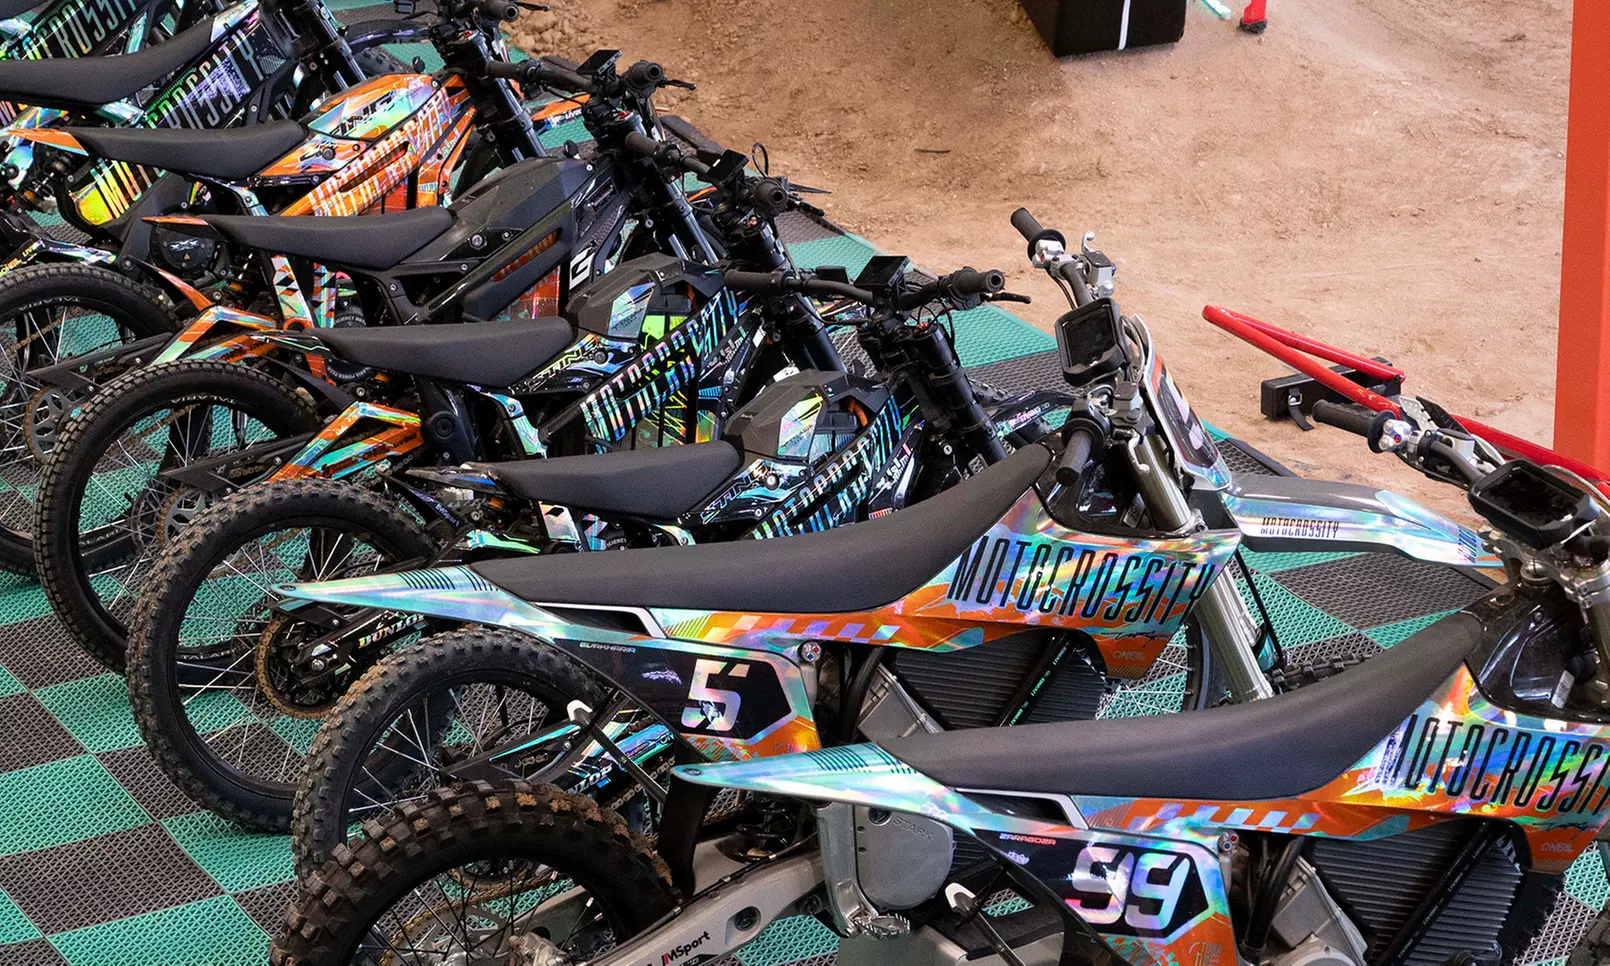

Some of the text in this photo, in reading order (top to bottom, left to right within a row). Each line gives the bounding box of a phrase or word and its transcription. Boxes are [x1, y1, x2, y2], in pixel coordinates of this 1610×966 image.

[1260, 517, 1340, 539] MOTOCROSSITY
[947, 535, 1216, 626] MOTOCROSSITY
[681, 658, 750, 731] 5
